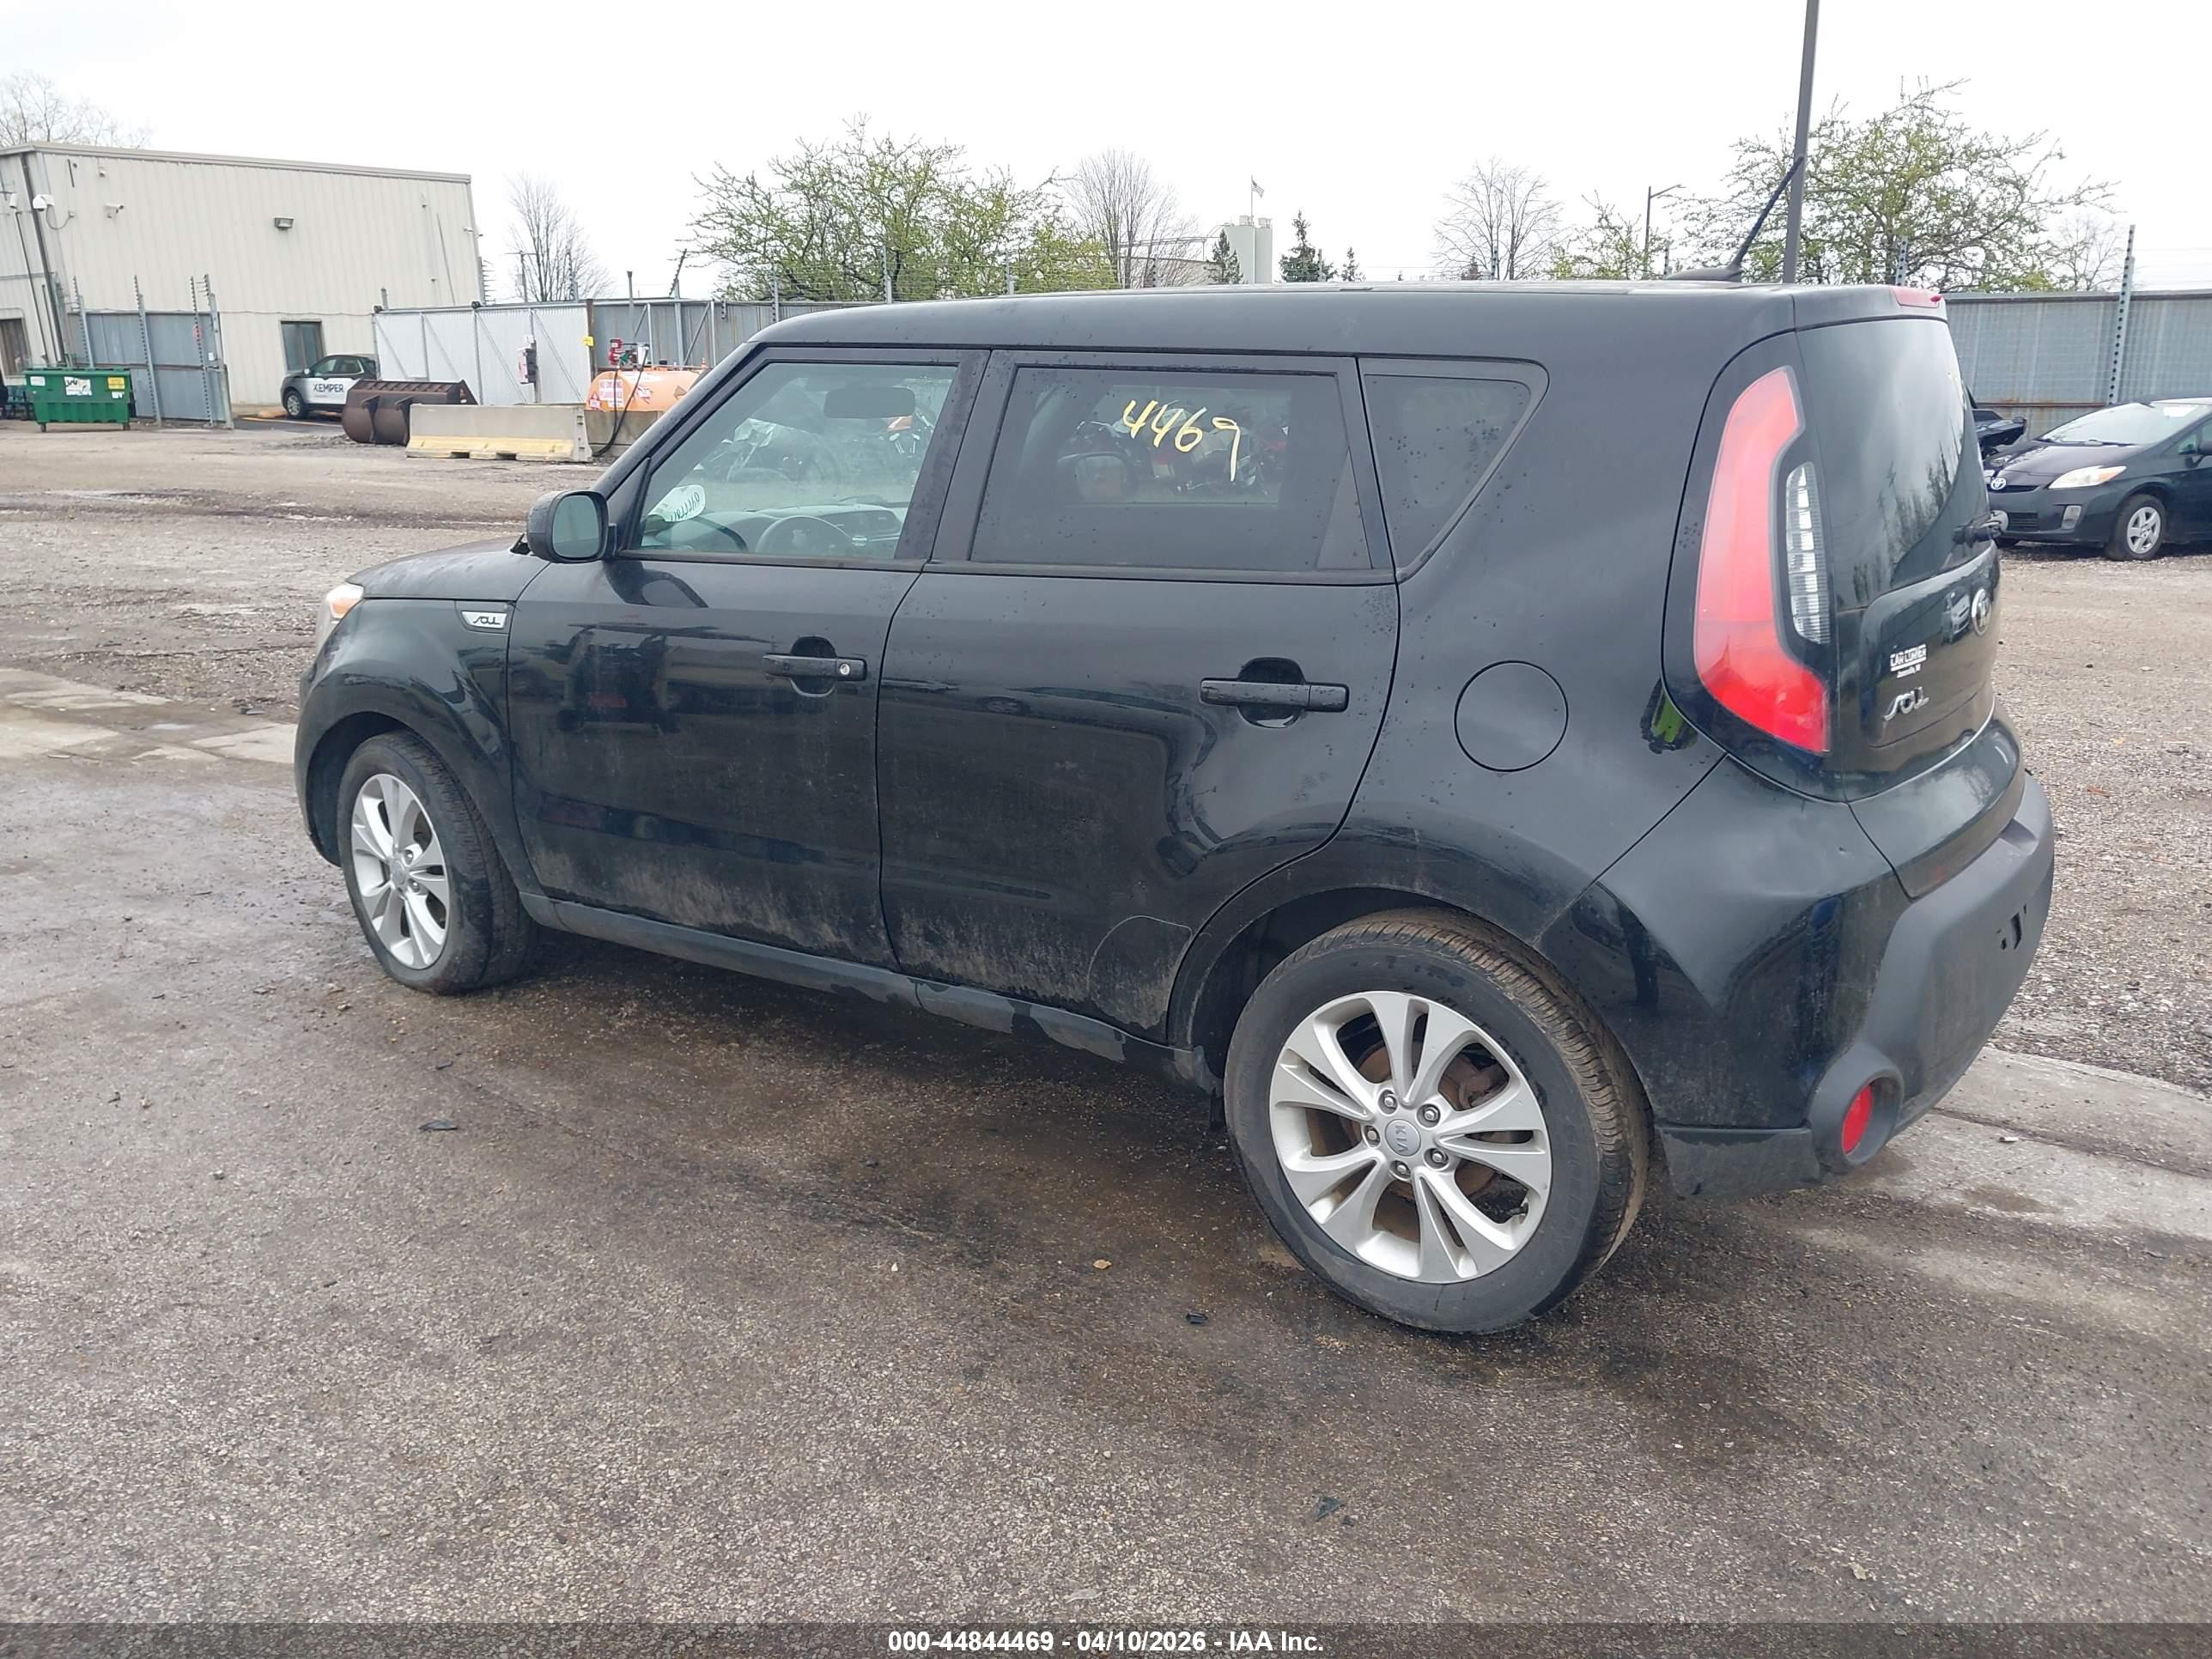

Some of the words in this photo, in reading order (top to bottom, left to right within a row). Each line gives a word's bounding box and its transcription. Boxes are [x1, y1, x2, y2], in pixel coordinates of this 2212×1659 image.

[313, 383, 344, 392] KEMPER
[1121, 399, 1241, 483] 4469
[1395, 1125, 1409, 1152] KIA
